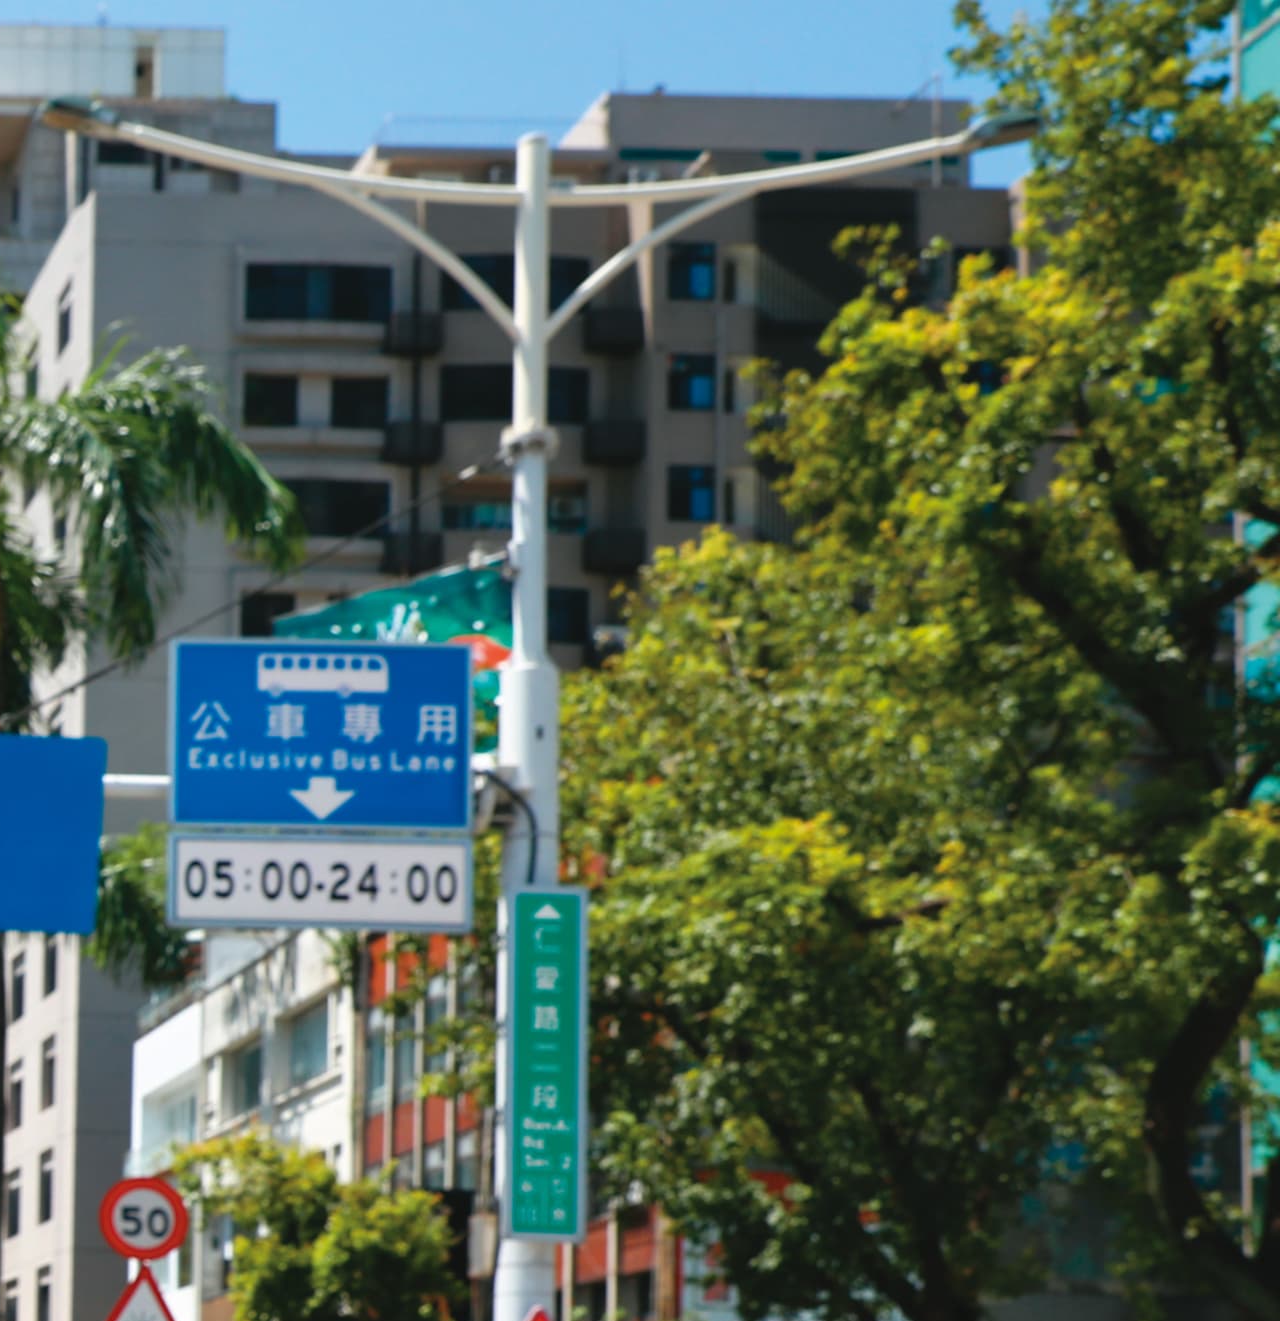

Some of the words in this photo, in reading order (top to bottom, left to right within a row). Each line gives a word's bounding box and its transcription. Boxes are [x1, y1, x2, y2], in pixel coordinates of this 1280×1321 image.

[190, 701, 458, 745] 公車專用
[188, 747, 324, 769] Exclusive
[331, 748, 382, 771] Bus
[390, 750, 456, 772] Lane
[121, 1205, 170, 1238] 50
